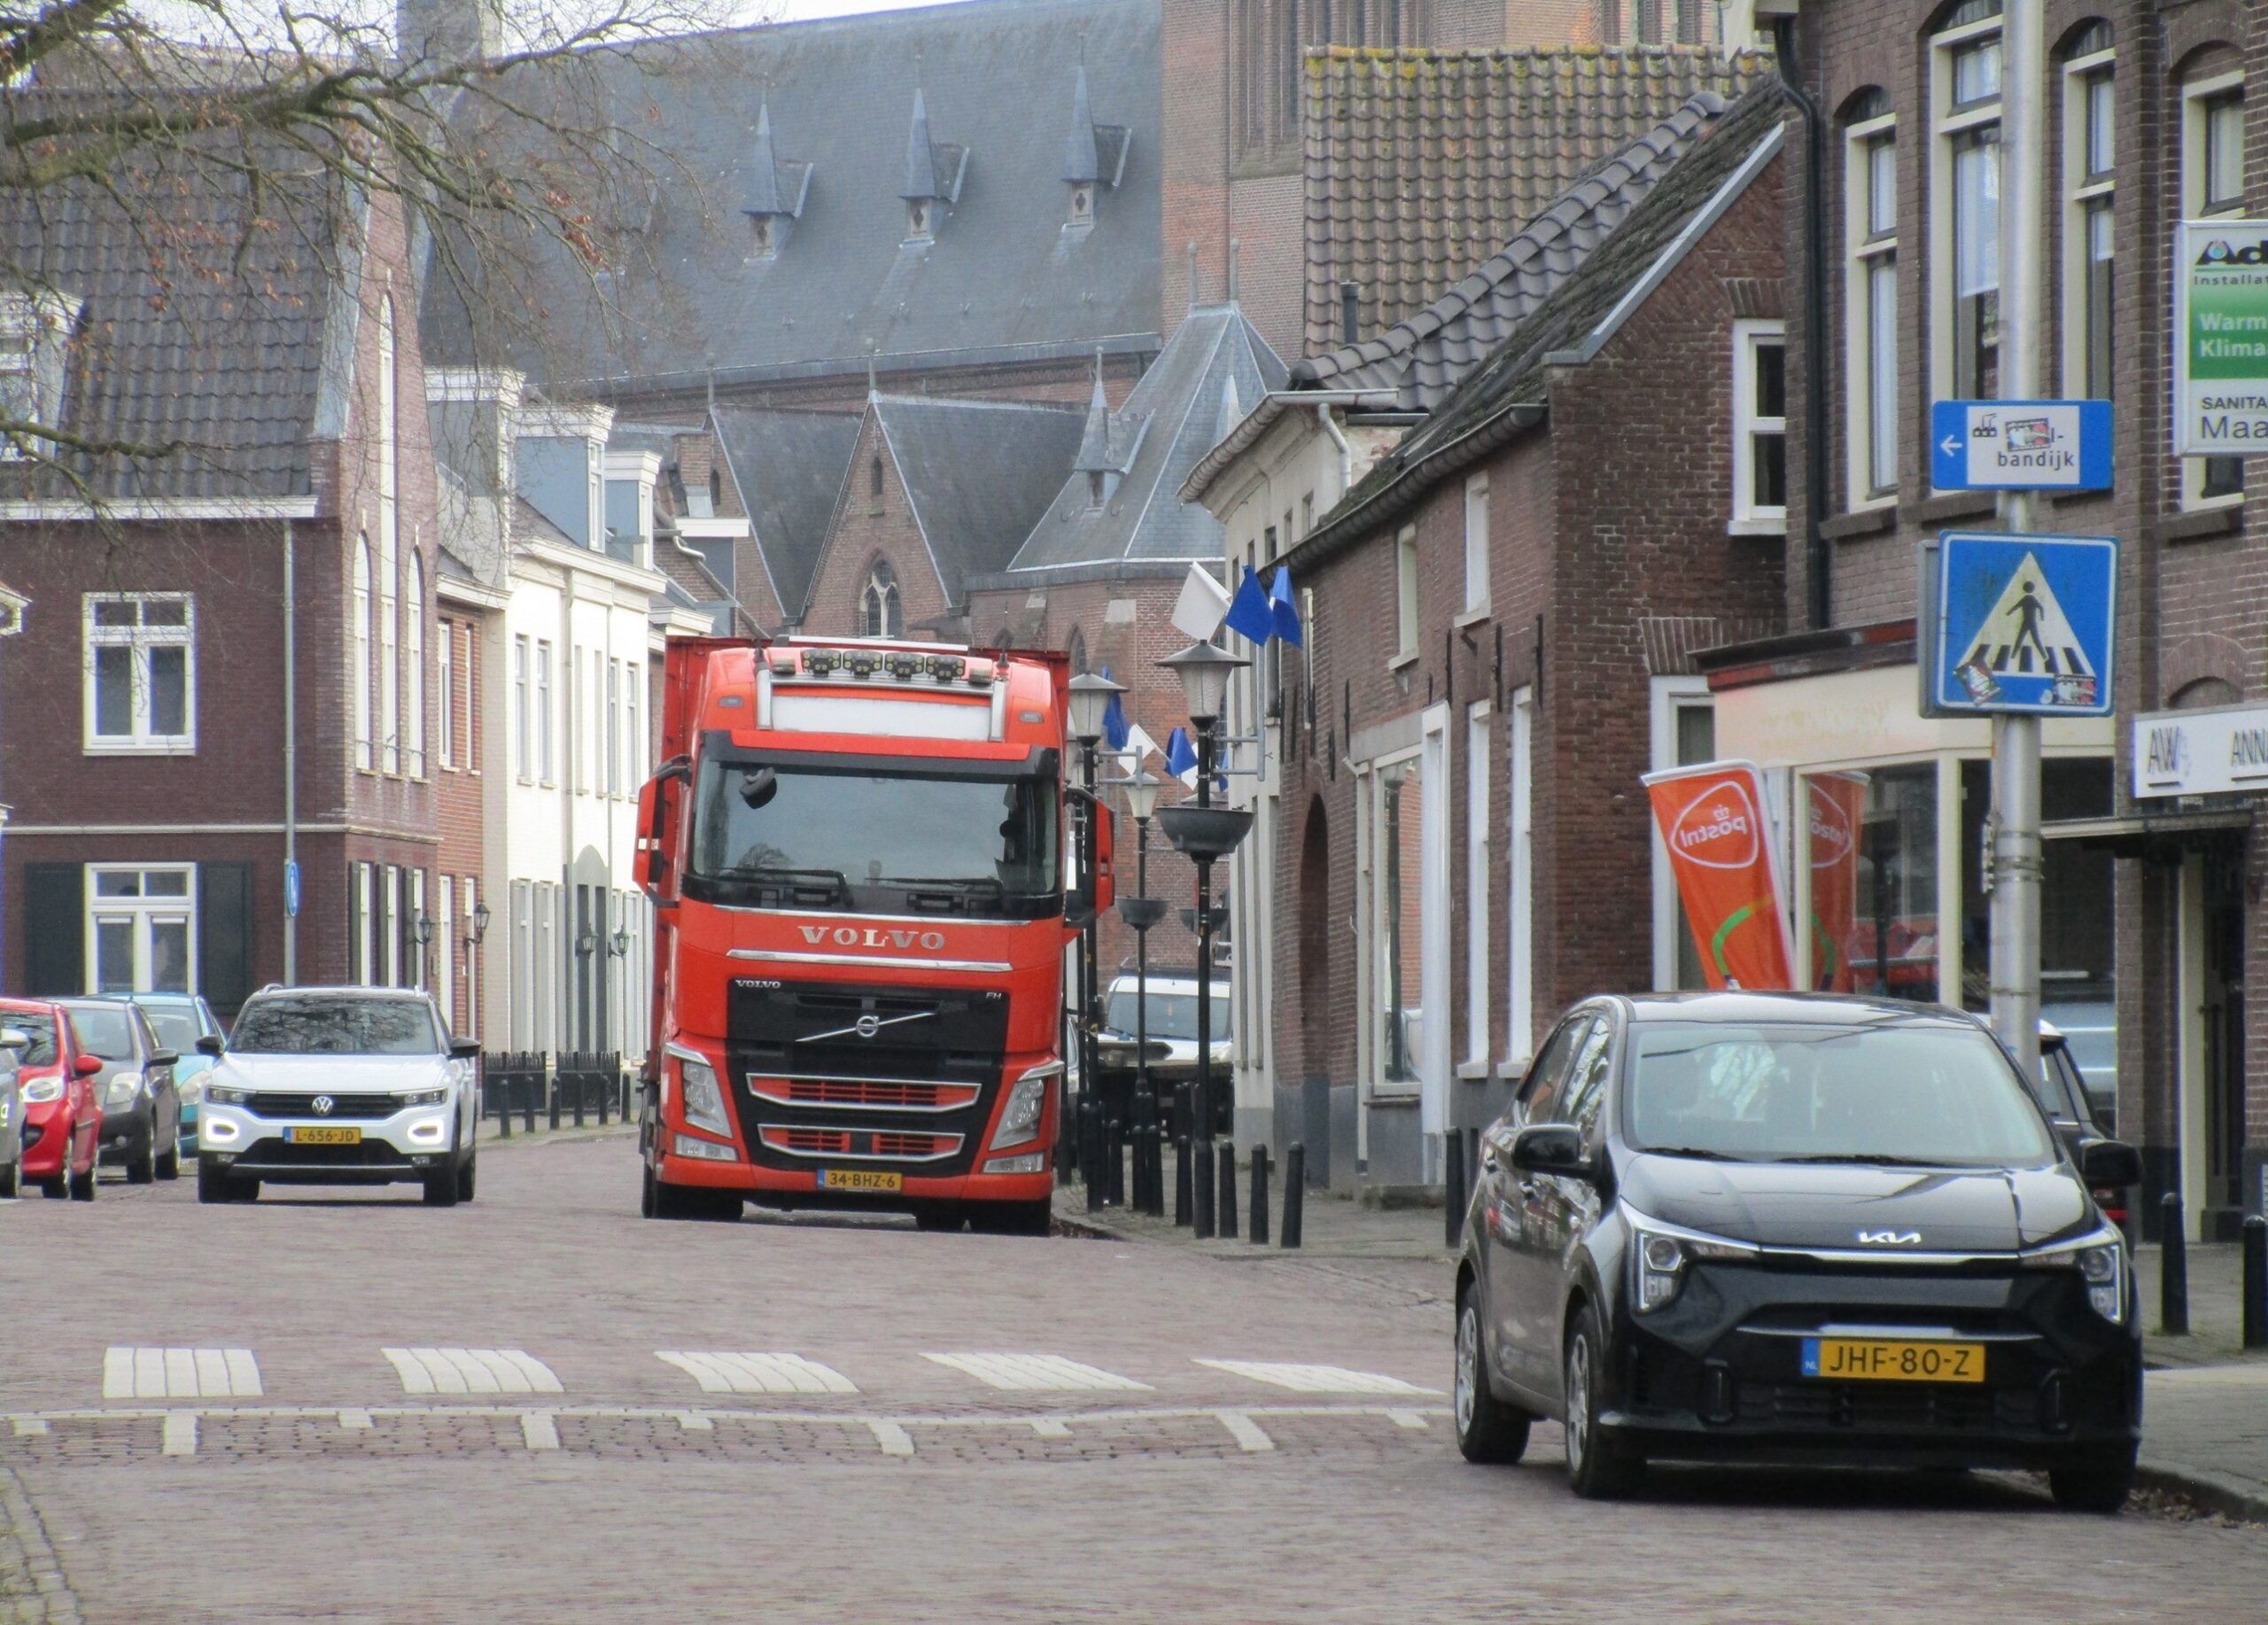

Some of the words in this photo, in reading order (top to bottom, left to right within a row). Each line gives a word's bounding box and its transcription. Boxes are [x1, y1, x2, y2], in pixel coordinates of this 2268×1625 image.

[2202, 397, 2268, 410] SANITA
[2202, 416, 2268, 439] Maa
[1998, 451, 2074, 471] bandijk
[797, 925, 945, 950] VOLVO
[735, 979, 781, 989] VOLVO
[295, 1130, 354, 1143] L-656-JD
[829, 1172, 896, 1188] 34-BHZ-6
[1829, 1345, 1971, 1376] JHF-80-Z
